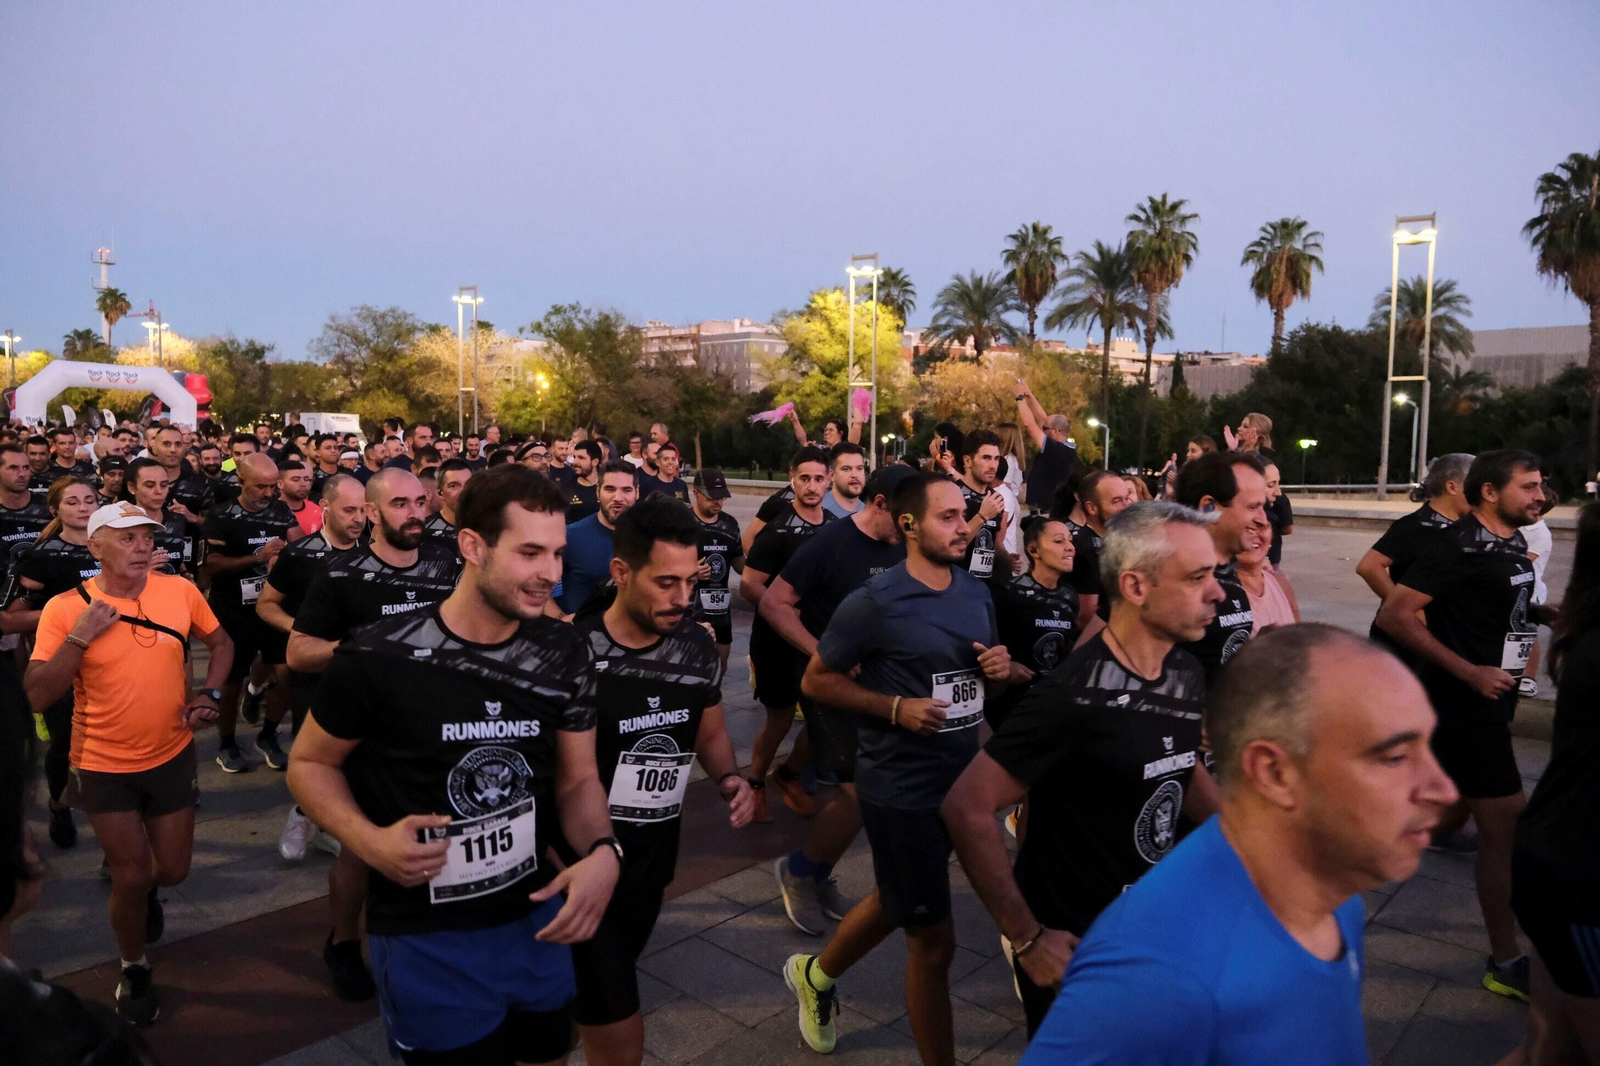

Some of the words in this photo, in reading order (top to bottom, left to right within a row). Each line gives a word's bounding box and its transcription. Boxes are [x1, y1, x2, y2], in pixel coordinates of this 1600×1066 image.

[869, 566, 884, 575] RUN
[710, 594, 724, 604] 954
[1035, 618, 1072, 630] RUNMONES
[1218, 610, 1253, 628] RUNMONE
[952, 680, 977, 704] 866
[441, 719, 541, 742] RUNMONES
[618, 708, 690, 734] RUNMONES
[1143, 750, 1197, 780] RUNMONES
[636, 767, 680, 793] 1086
[459, 824, 514, 864] 1115
